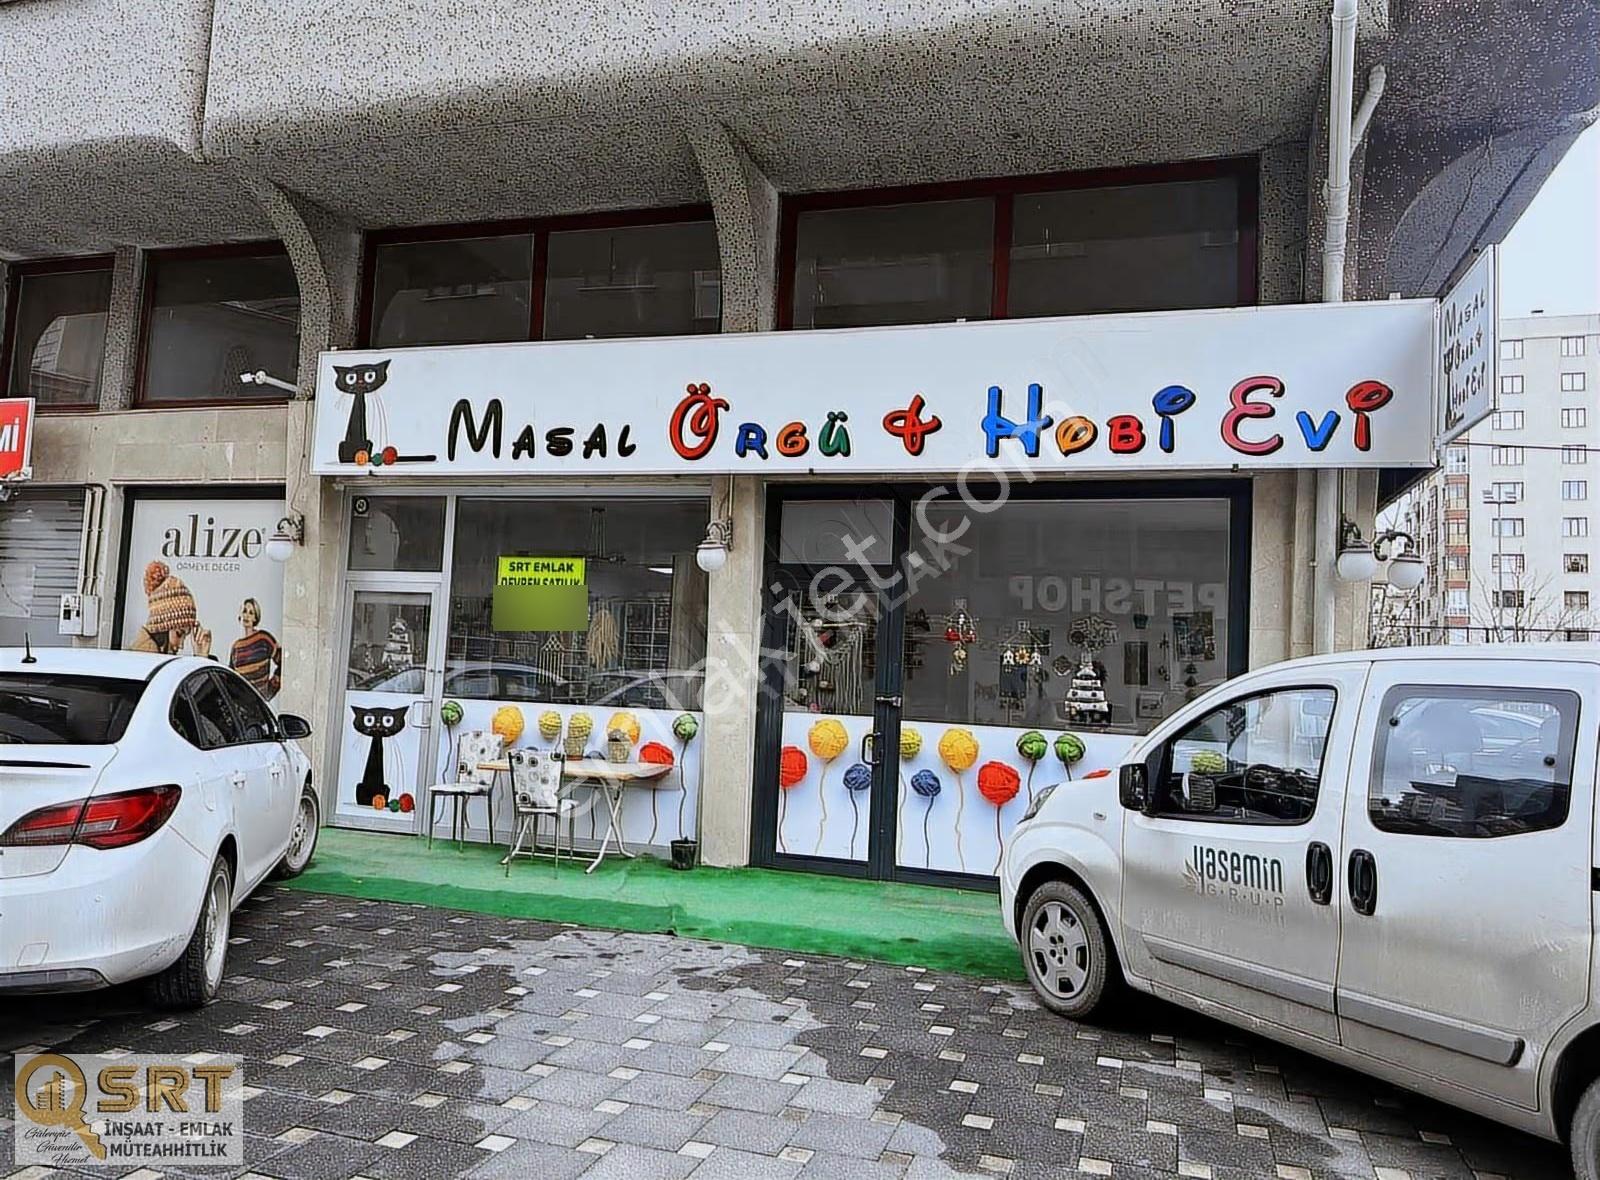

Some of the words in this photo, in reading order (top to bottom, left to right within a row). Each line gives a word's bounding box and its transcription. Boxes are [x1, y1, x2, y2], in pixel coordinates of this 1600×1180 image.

[883, 394, 943, 457] &
[162, 514, 262, 559] alize
[509, 562, 531, 572] SRT
[533, 562, 574, 573] EMLAK
